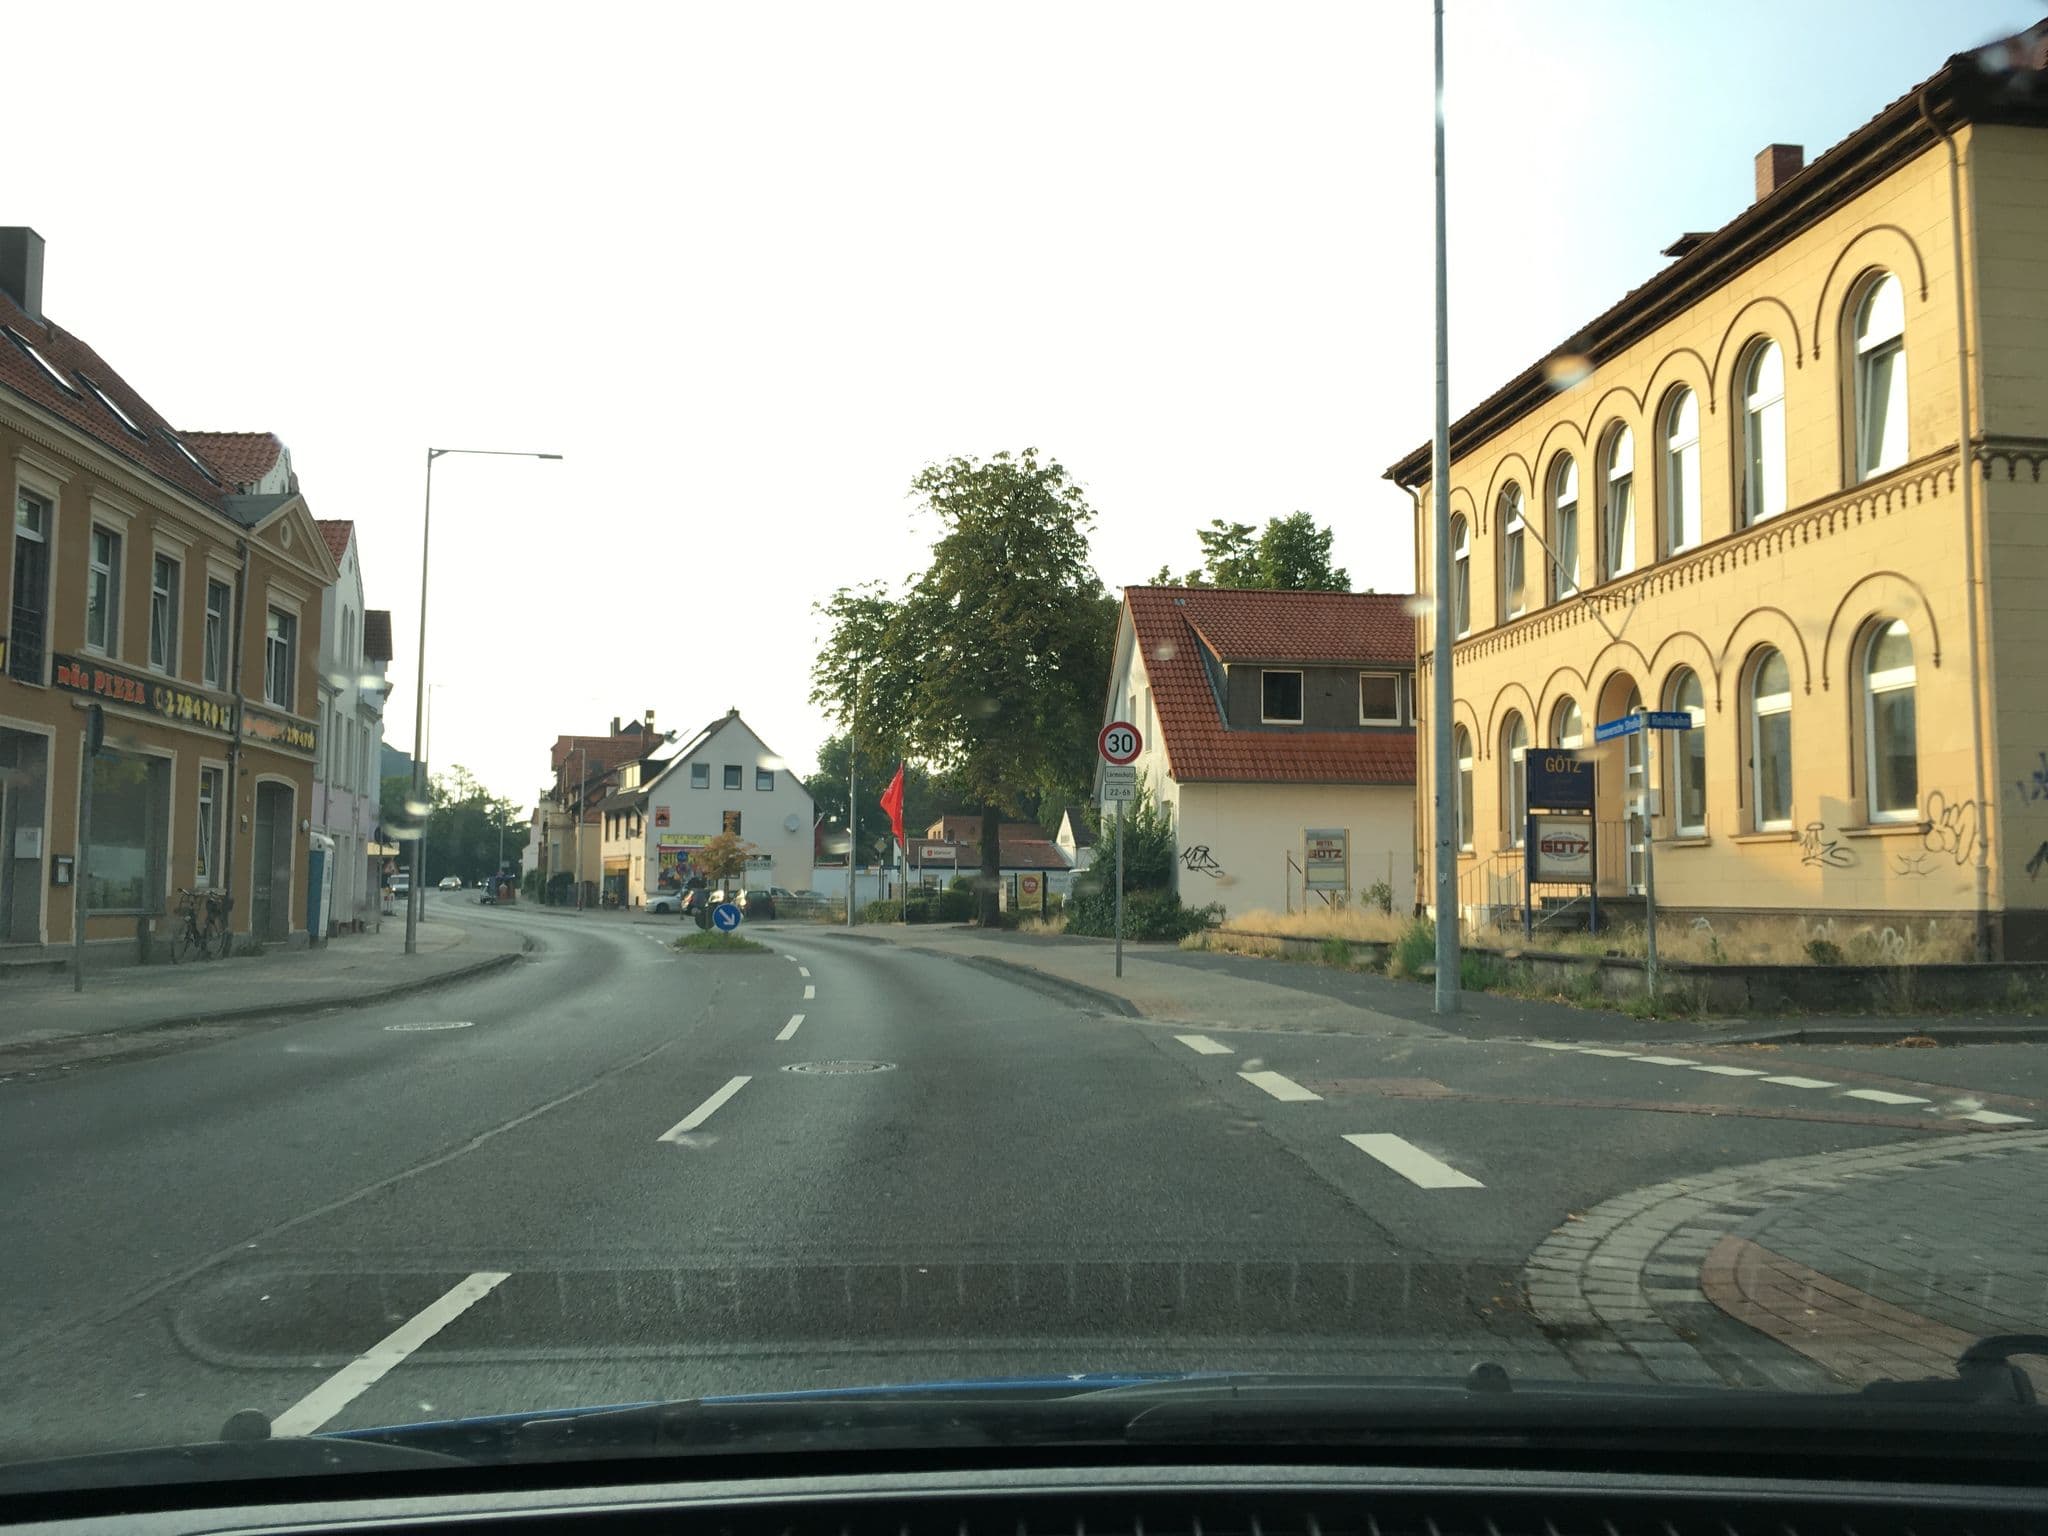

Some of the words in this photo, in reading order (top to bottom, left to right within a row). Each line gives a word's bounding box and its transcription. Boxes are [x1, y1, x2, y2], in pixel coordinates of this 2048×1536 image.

[94, 670, 146, 705] PIZZA
[1108, 734, 1132, 753] 30
[1545, 754, 1583, 773] GÖTZ
